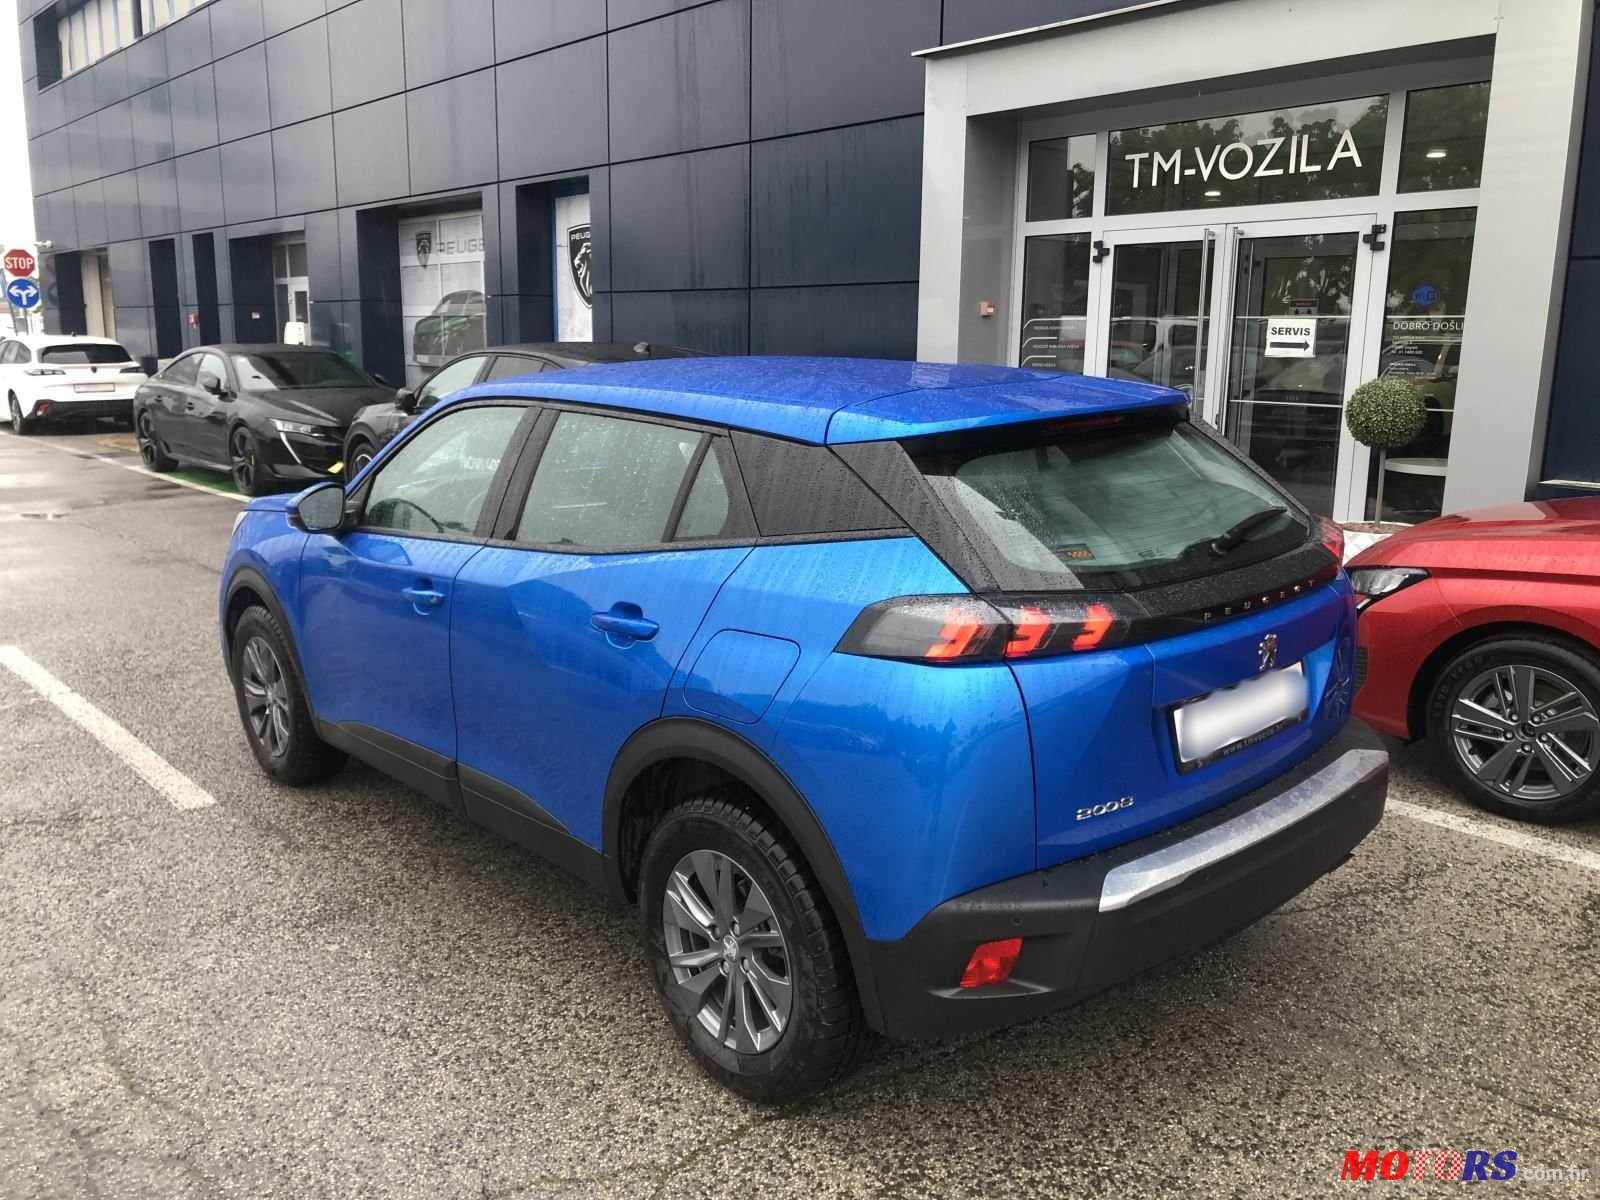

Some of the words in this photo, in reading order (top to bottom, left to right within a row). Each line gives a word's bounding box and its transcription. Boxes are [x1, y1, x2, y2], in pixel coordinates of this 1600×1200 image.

[1125, 129, 1362, 188] TM-VOZILA
[5, 256, 35, 270] STOP
[1270, 326, 1311, 336] SERVIS
[1393, 321, 1430, 331] DOBRO
[1432, 319, 1465, 331] DOŠLI
[1204, 580, 1315, 620] PEUGEOT
[1076, 795, 1135, 821] 2008
